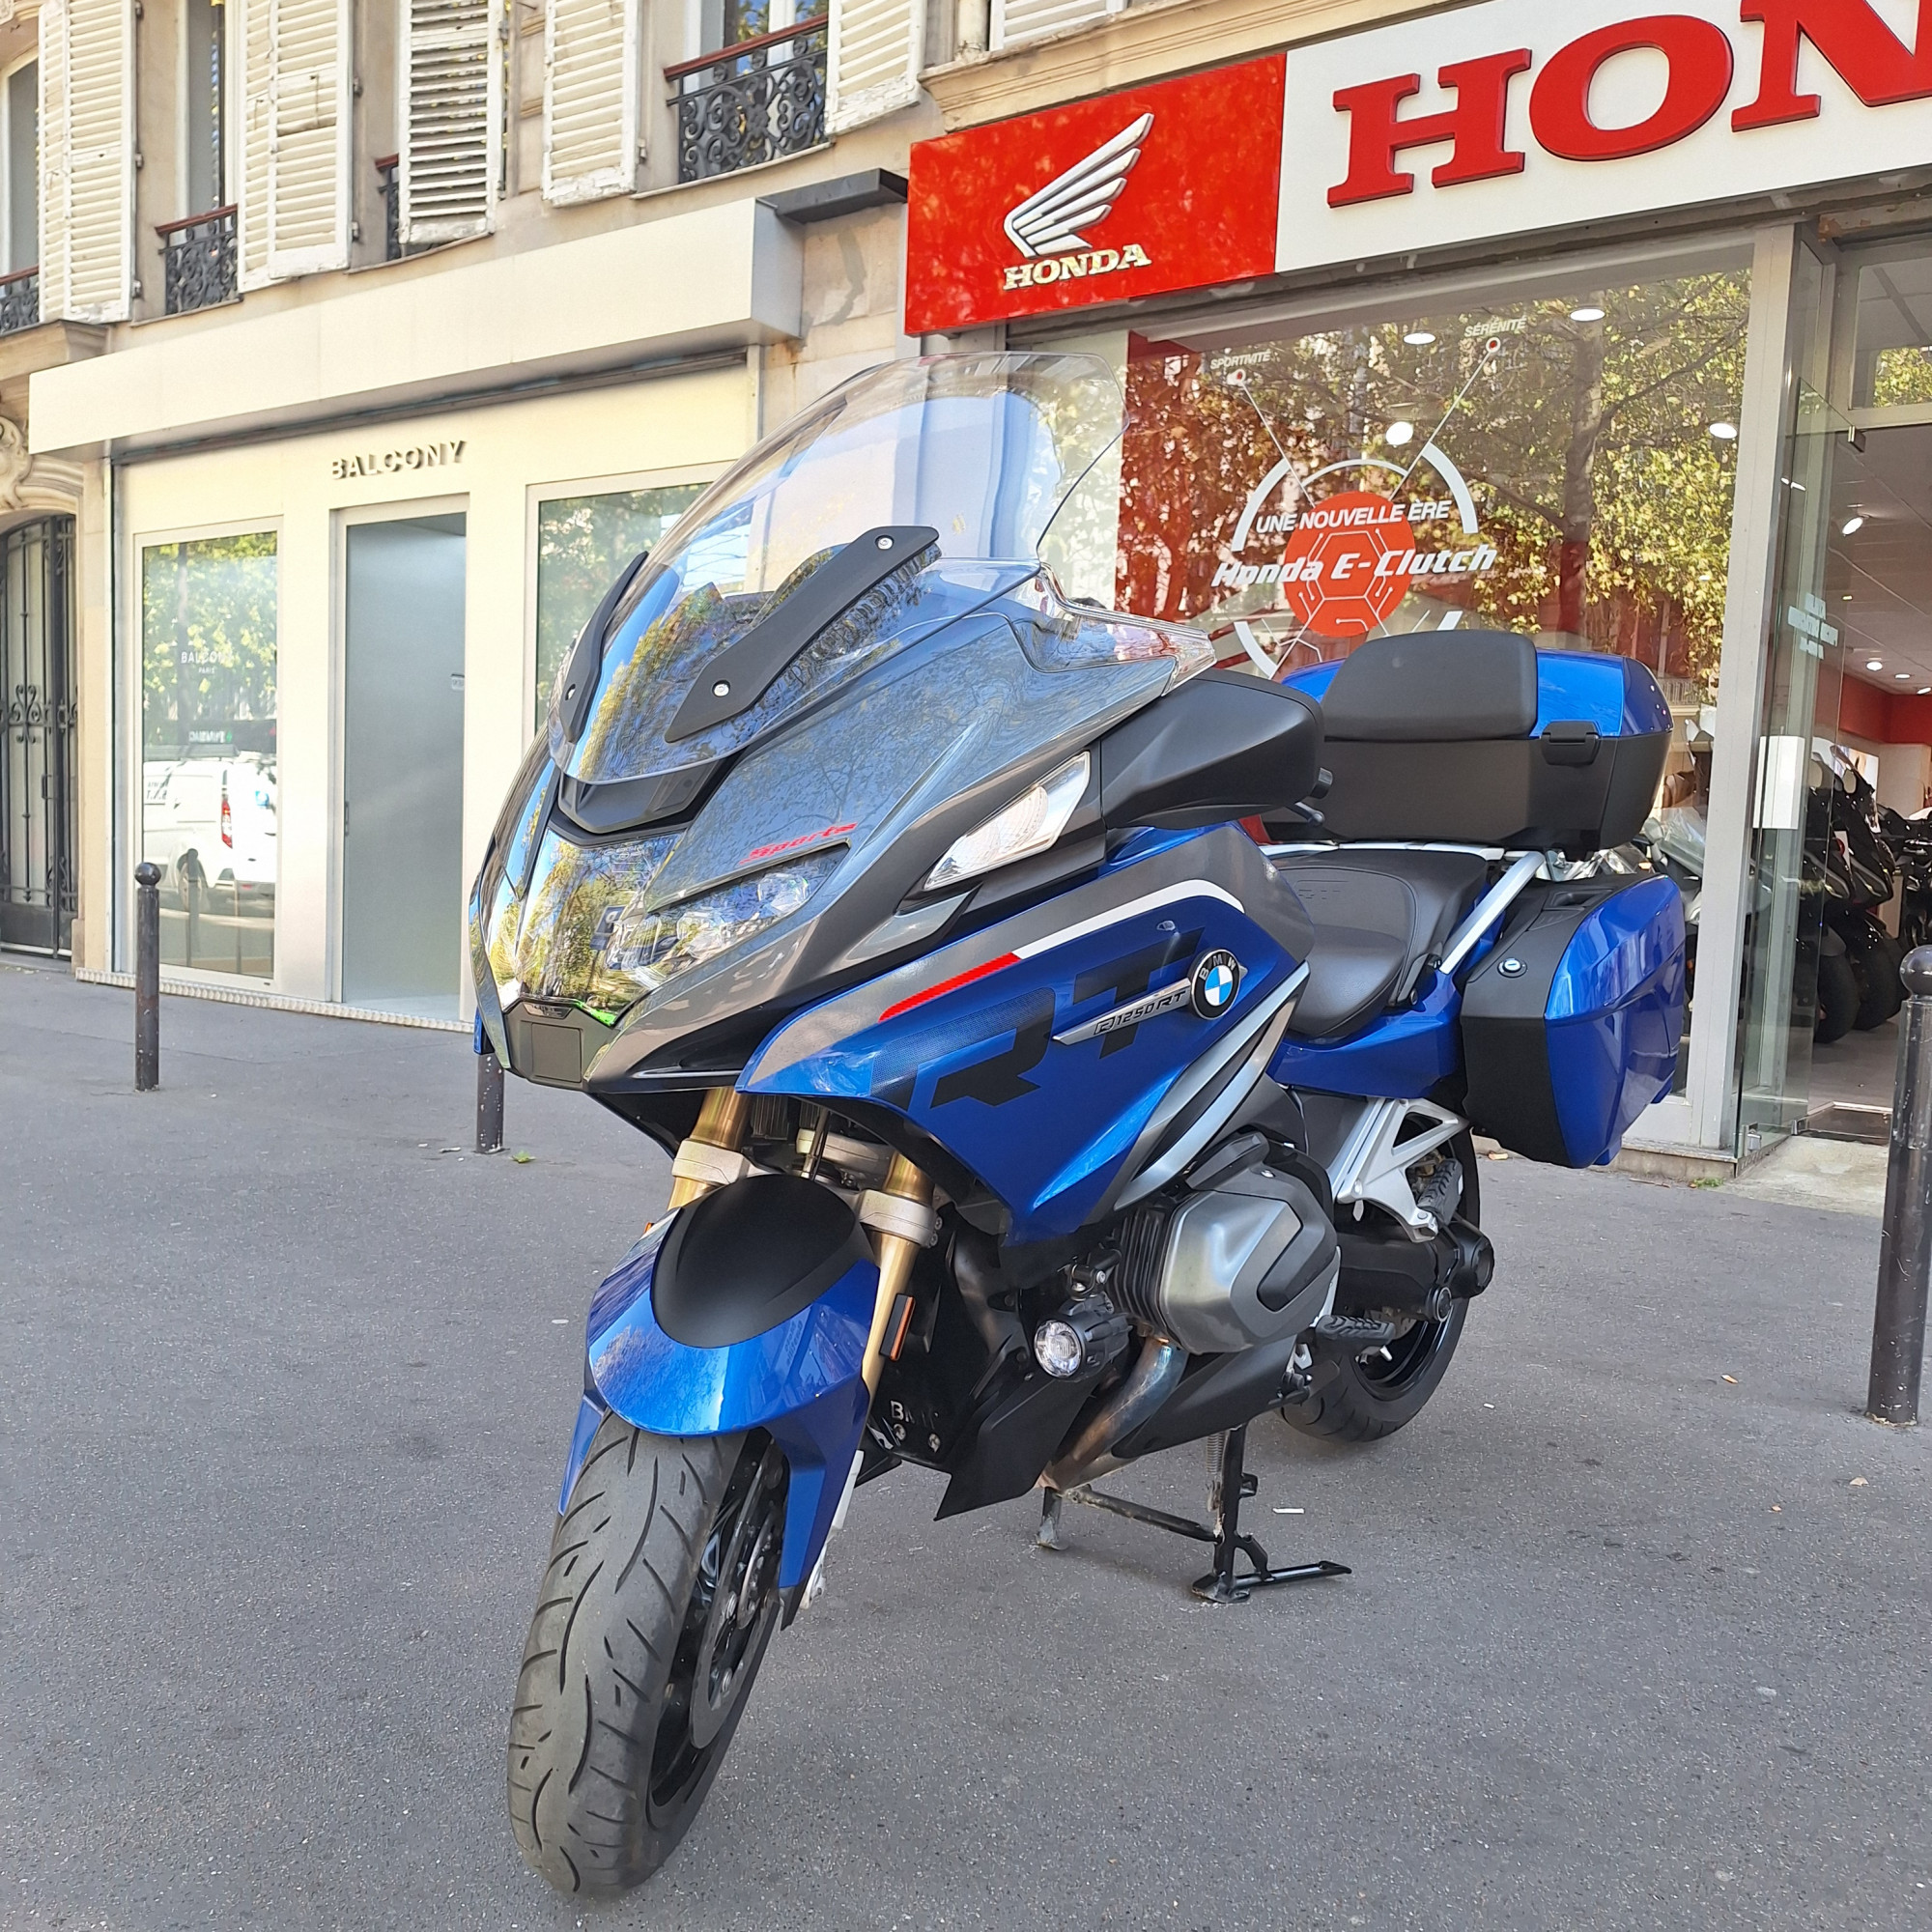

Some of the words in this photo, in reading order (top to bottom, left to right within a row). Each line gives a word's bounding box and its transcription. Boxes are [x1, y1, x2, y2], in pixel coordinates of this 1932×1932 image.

[1003, 243, 1152, 291] HONDA
[1463, 314, 1527, 337] SÉRÉNITÉ
[1210, 349, 1271, 370] SPORTIVITÉ
[330, 440, 468, 480] BALCONY
[1256, 513, 1298, 534] UNE
[1298, 503, 1406, 530] NOUVELLE
[1406, 498, 1452, 522] ÈRE
[1210, 556, 1323, 587] Honda
[1330, 544, 1497, 580] E-Clutch
[1199, 953, 1236, 981] BMW
